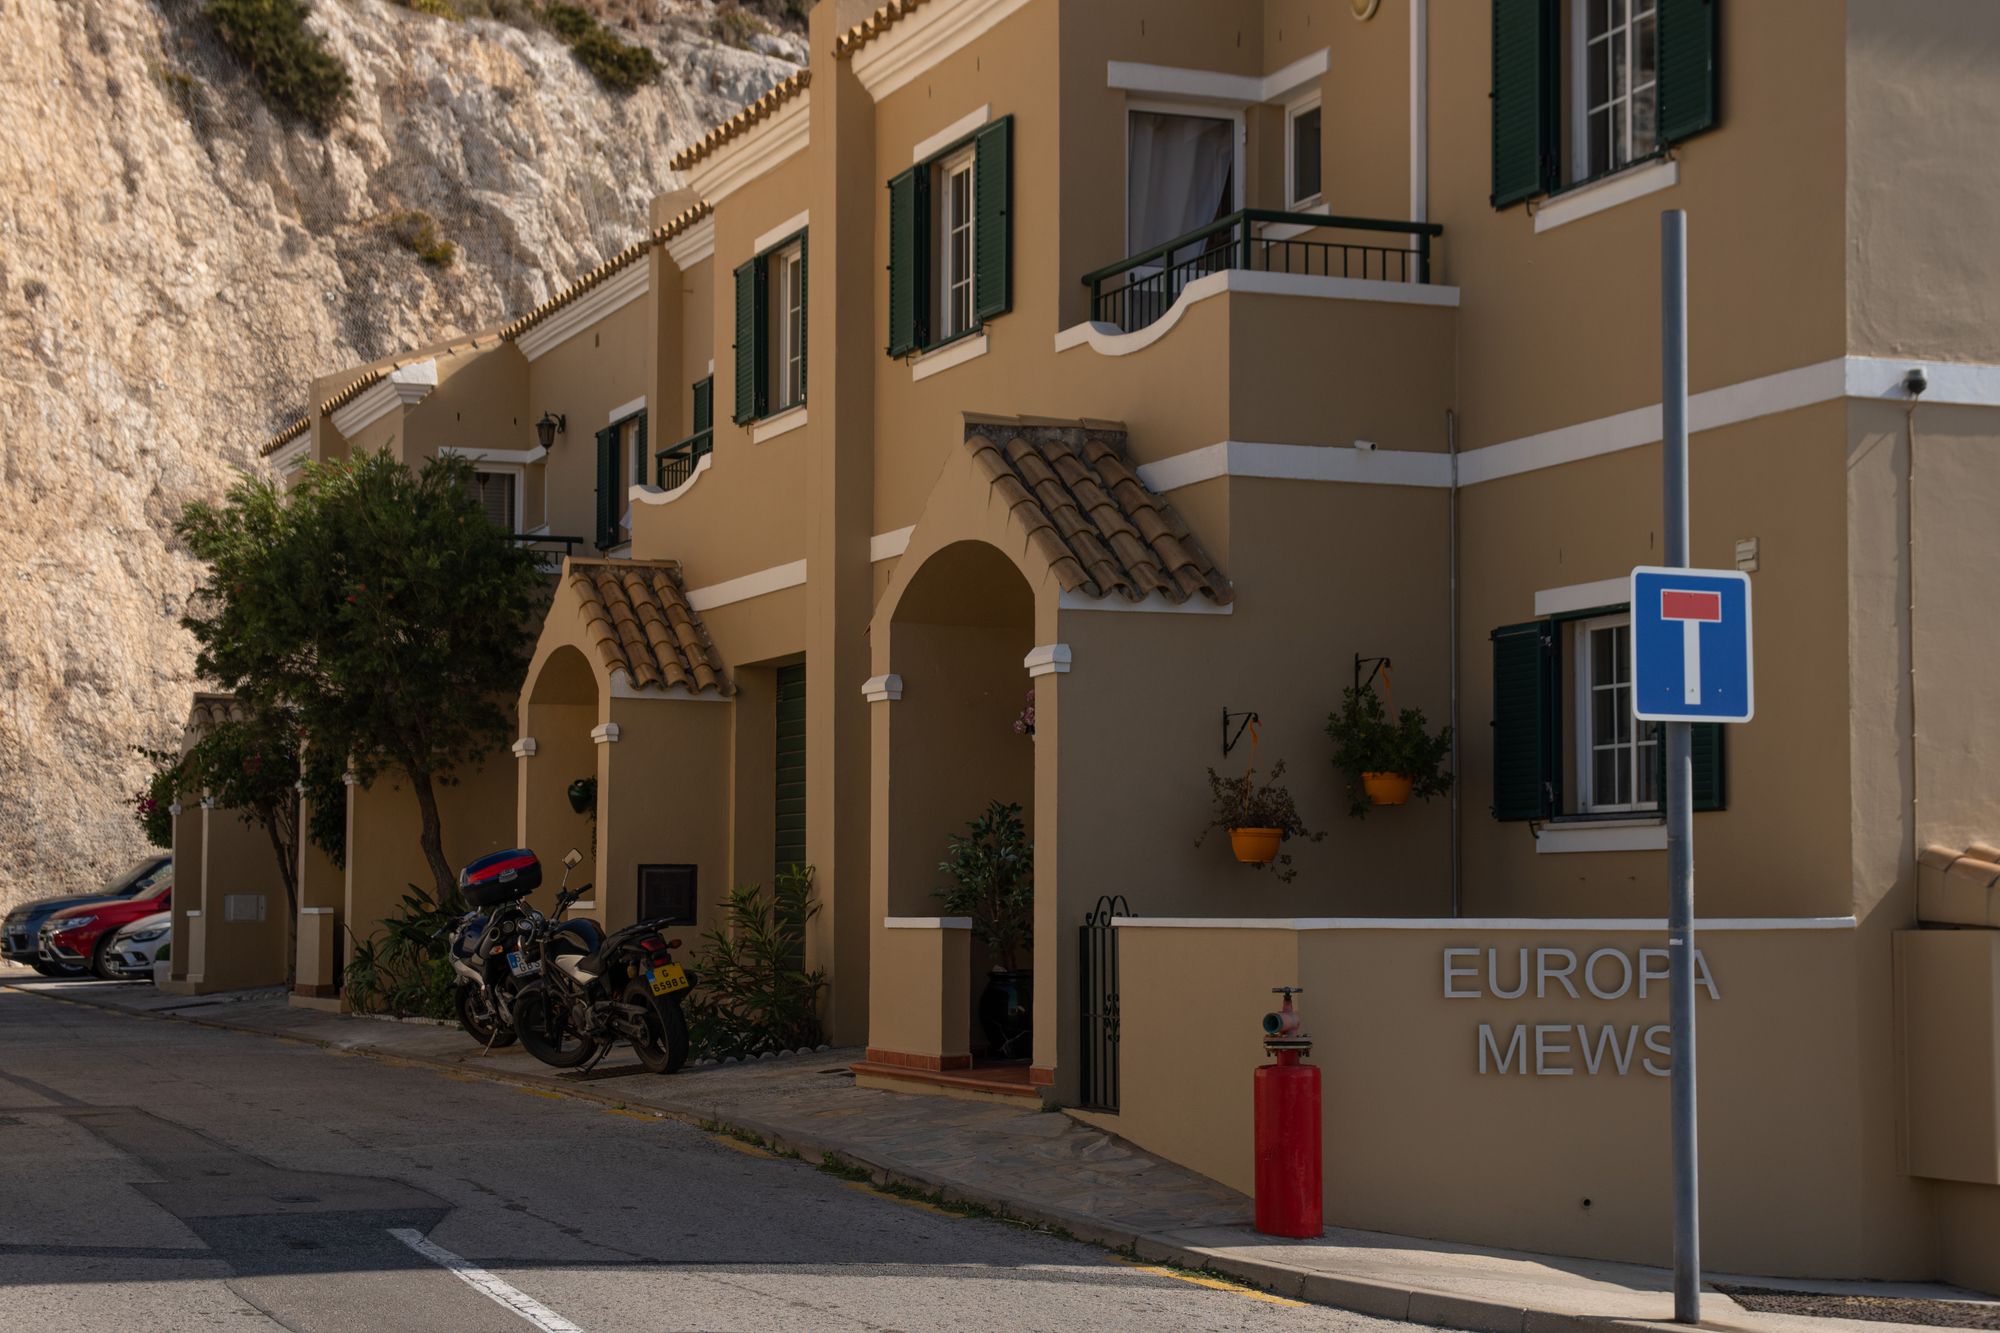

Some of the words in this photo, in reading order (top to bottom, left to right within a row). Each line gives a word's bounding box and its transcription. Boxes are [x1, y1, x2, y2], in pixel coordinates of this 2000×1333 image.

[661, 969, 669, 977] G
[1443, 948, 1721, 1000] EUROPA
[1478, 1024, 1672, 1077] MEWS
